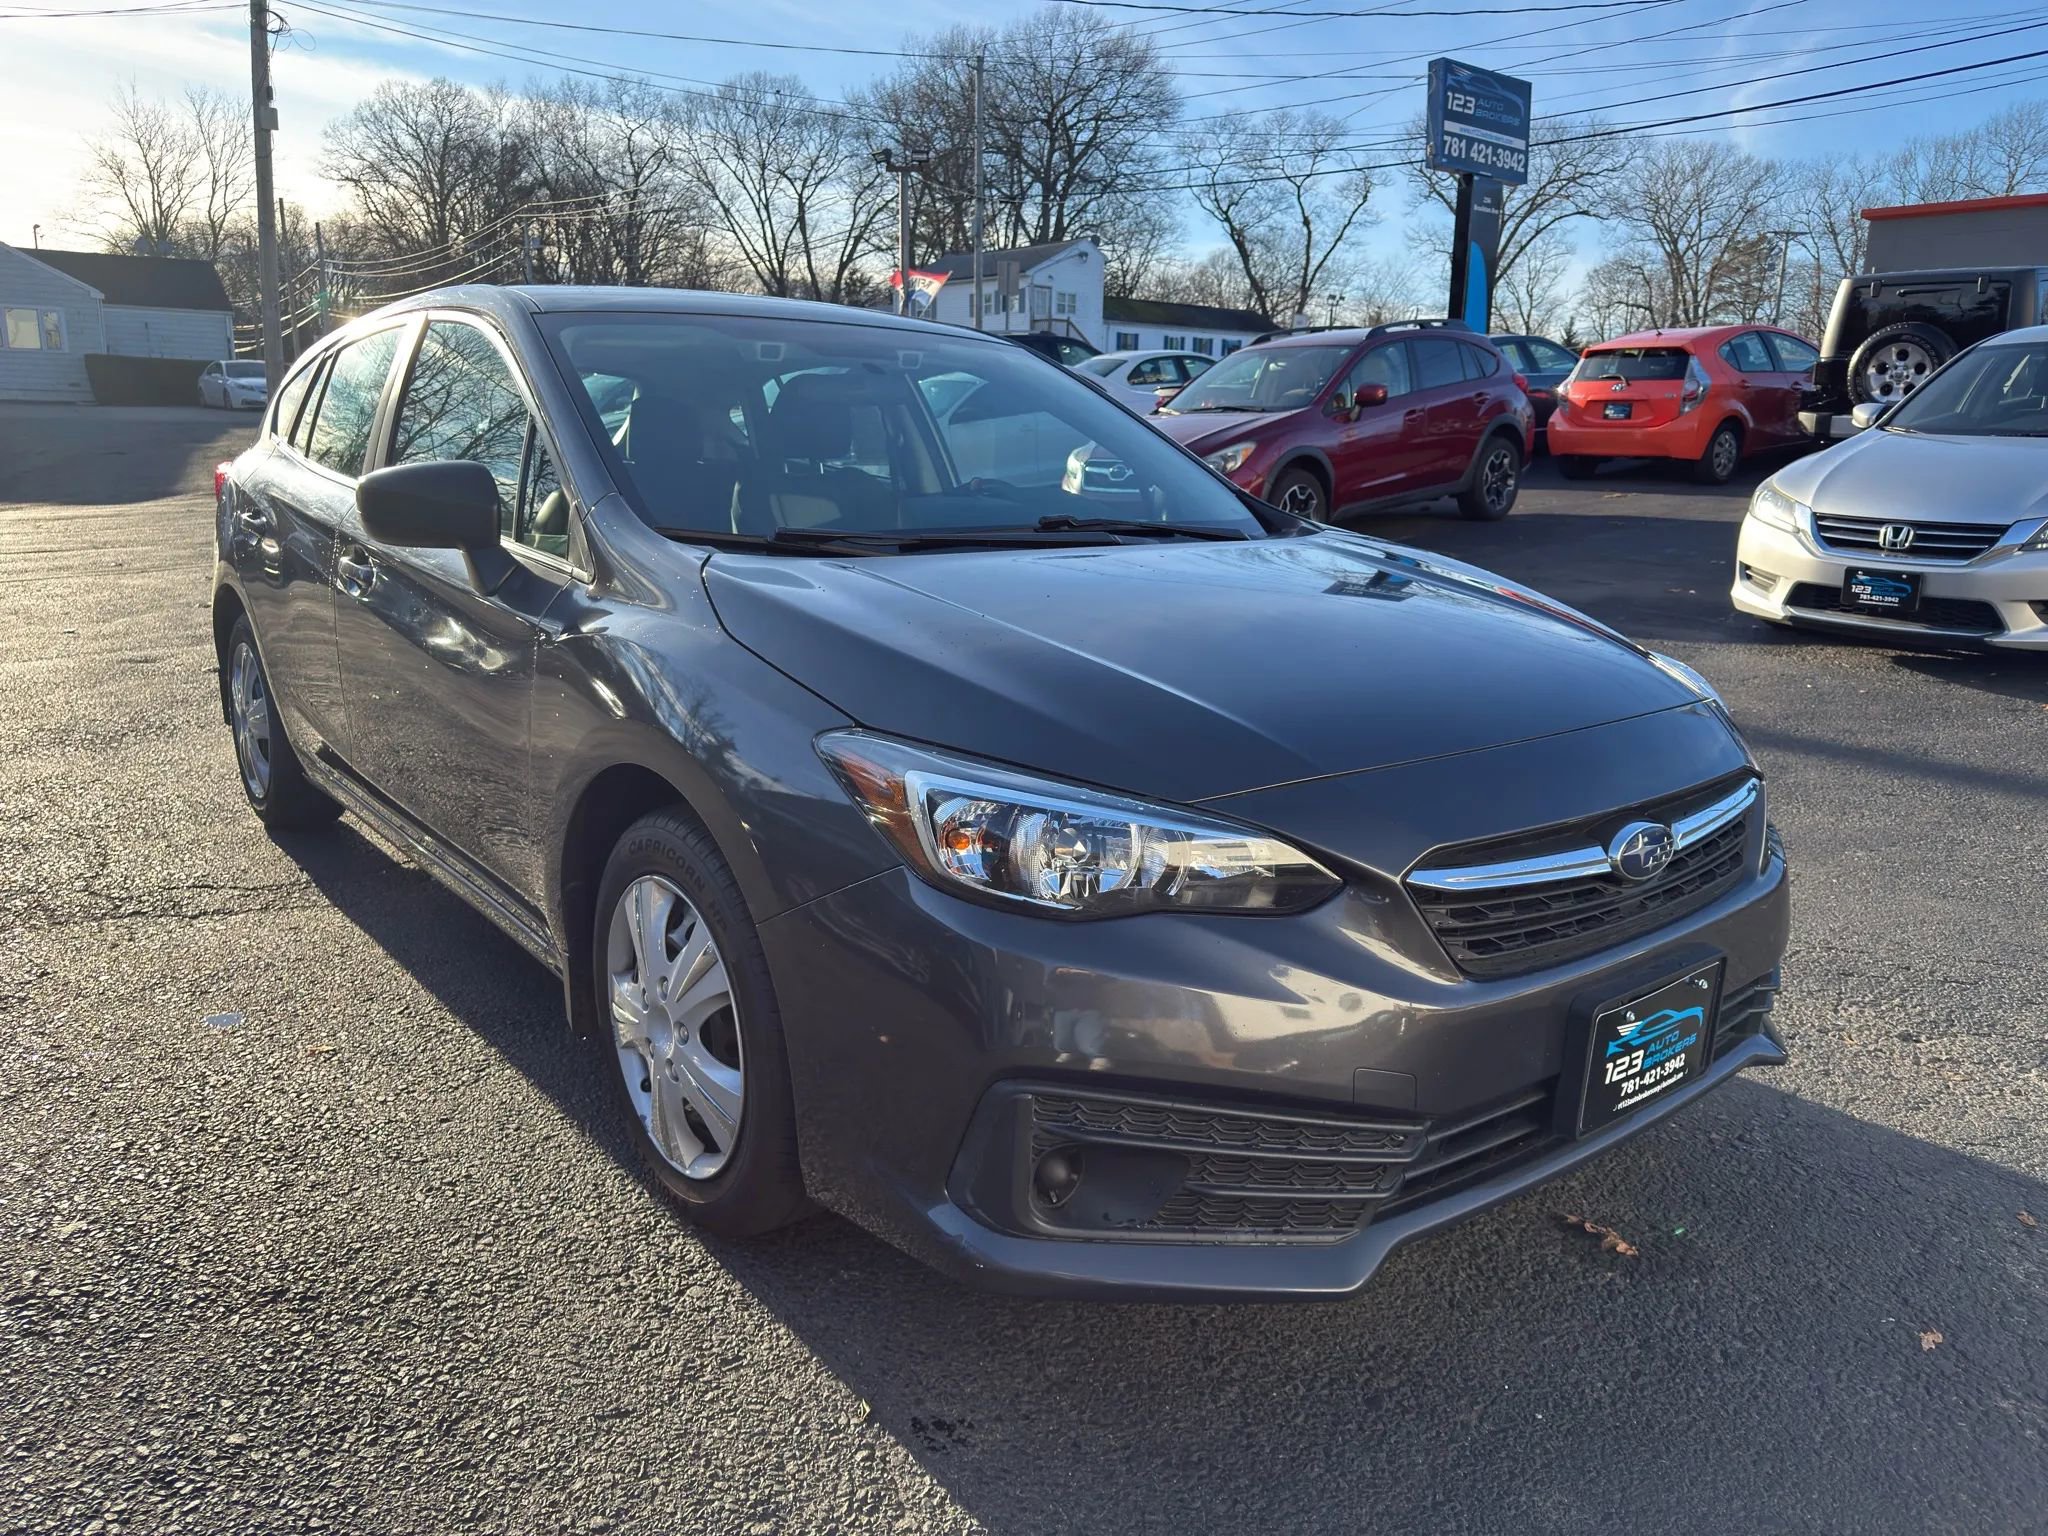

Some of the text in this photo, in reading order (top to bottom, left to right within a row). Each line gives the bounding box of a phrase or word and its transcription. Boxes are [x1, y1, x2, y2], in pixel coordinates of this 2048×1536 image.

[1447, 92, 1476, 115] 123
[1477, 98, 1504, 111] AUTO
[1444, 135, 1466, 159] 781
[1470, 142, 1525, 173] 421-3942
[1851, 584, 1872, 594] 123
[629, 838, 706, 892] CAPRICORN
[1642, 1033, 1698, 1069] BROKERS
[1646, 1030, 1680, 1055] AUTO
[1604, 1049, 1645, 1085] 123
[1620, 1052, 1686, 1096] 781-421-3942
